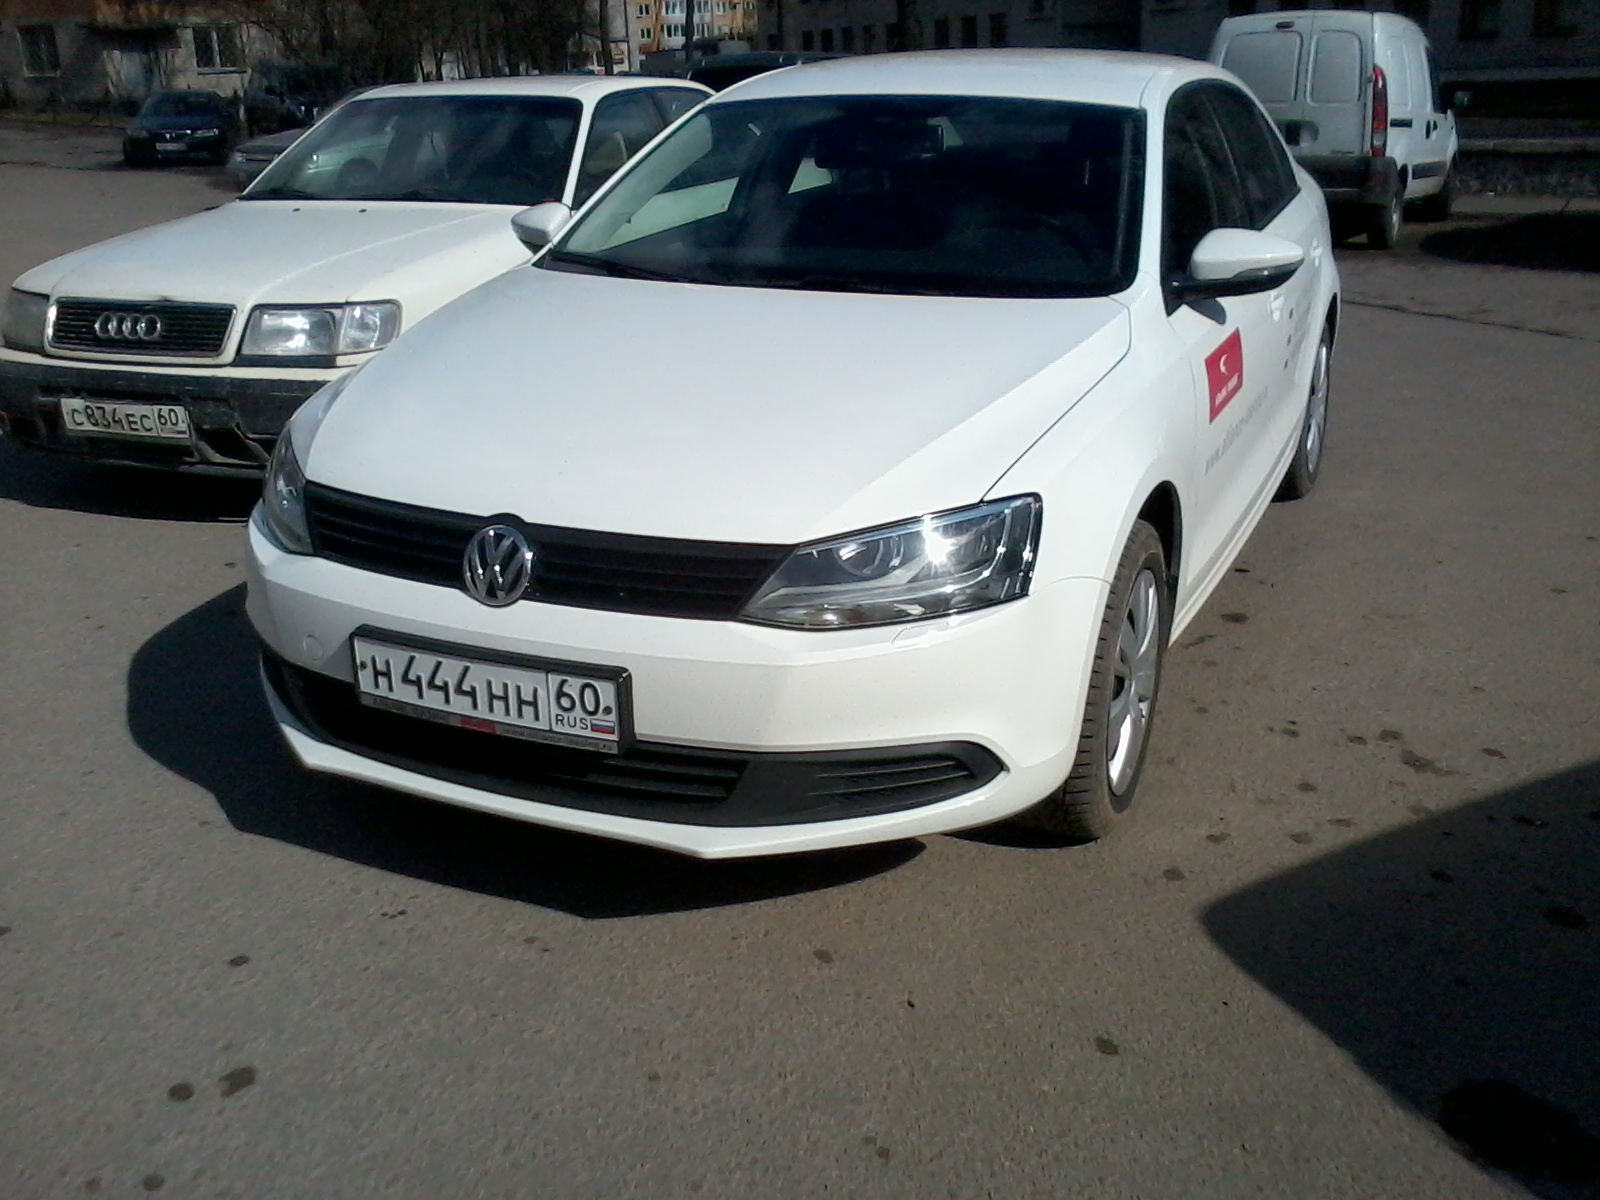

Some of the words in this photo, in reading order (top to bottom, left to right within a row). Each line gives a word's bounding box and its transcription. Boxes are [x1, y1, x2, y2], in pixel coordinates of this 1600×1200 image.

[71, 404, 153, 432] C834EC
[157, 408, 179, 427] 60
[371, 654, 541, 722] H444HH
[554, 678, 602, 717] 60
[555, 713, 589, 731] RUS
